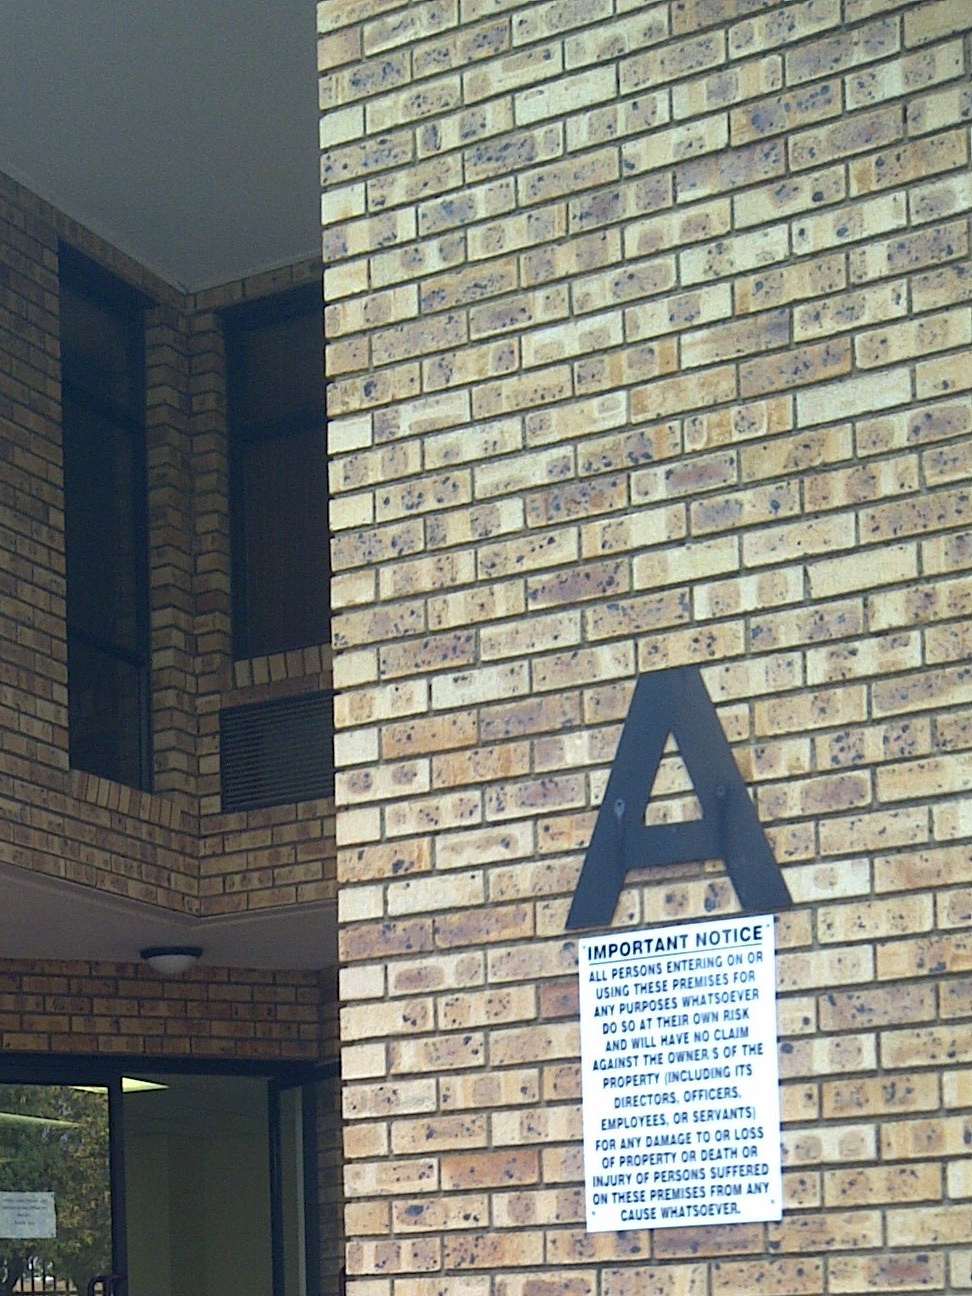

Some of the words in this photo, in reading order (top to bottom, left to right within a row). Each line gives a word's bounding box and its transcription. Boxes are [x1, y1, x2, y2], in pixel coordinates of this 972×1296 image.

[565, 666, 793, 929] A
[587, 934, 689, 961] IMPORTANT
[696, 925, 763, 947] NOTICE
[588, 970, 608, 983] ALL
[611, 962, 663, 980] PERSONS
[666, 955, 723, 974] ENTERING
[727, 953, 743, 966] ON
[747, 951, 764, 964] OR
[596, 984, 630, 1000] USING
[634, 980, 668, 995] THESE
[672, 973, 729, 991] PREMISES
[733, 970, 756, 983] FOR
[594, 1004, 615, 1018] ANY
[619, 997, 678, 1015] PURPOSES
[682, 988, 760, 1008] WHATSOEVER
[602, 1021, 617, 1035] DO
[621, 1020, 636, 1033] SO
[639, 1017, 653, 1031] AT
[657, 1014, 689, 1029] THEIR
[693, 1011, 719, 1025] OWN
[723, 1007, 750, 1021] RISK
[605, 1039, 628, 1052] AND
[631, 1036, 657, 1050] WILL
[661, 1031, 690, 1046] HAVE
[693, 1029, 710, 1043] NO
[713, 1026, 749, 1042] CLAIM
[592, 1055, 639, 1072] AGAINST
[643, 1053, 664, 1066] THE
[723, 1045, 737, 1058] OF
[742, 1042, 764, 1056] THE
[602, 1072, 660, 1089] PROPERTY
[735, 1063, 753, 1077] ITS
[673, 1111, 689, 1125] OR
[595, 1139, 617, 1152] FOR
[620, 1136, 642, 1150] ANY
[645, 1132, 692, 1148] DAMAGE
[696, 1131, 710, 1143] TO
[714, 1129, 730, 1142] OR
[734, 1126, 764, 1141] LOSS
[601, 1156, 615, 1169] OF
[619, 1151, 677, 1168] PROPERTY
[681, 1150, 697, 1163] OR
[700, 1147, 738, 1161] DEATH
[742, 1145, 758, 1158] OR
[592, 1173, 632, 1188] INJURY
[636, 1171, 650, 1185] OF
[653, 1167, 706, 1183] PERSONS
[710, 1163, 769, 1179] SUFFERED
[592, 1192, 608, 1206] ON
[612, 1190, 646, 1204] THESE
[650, 1186, 706, 1201] PREMISES
[710, 1183, 742, 1198] FROM
[746, 1181, 770, 1195] ANY
[620, 1207, 657, 1222] CAUSE
